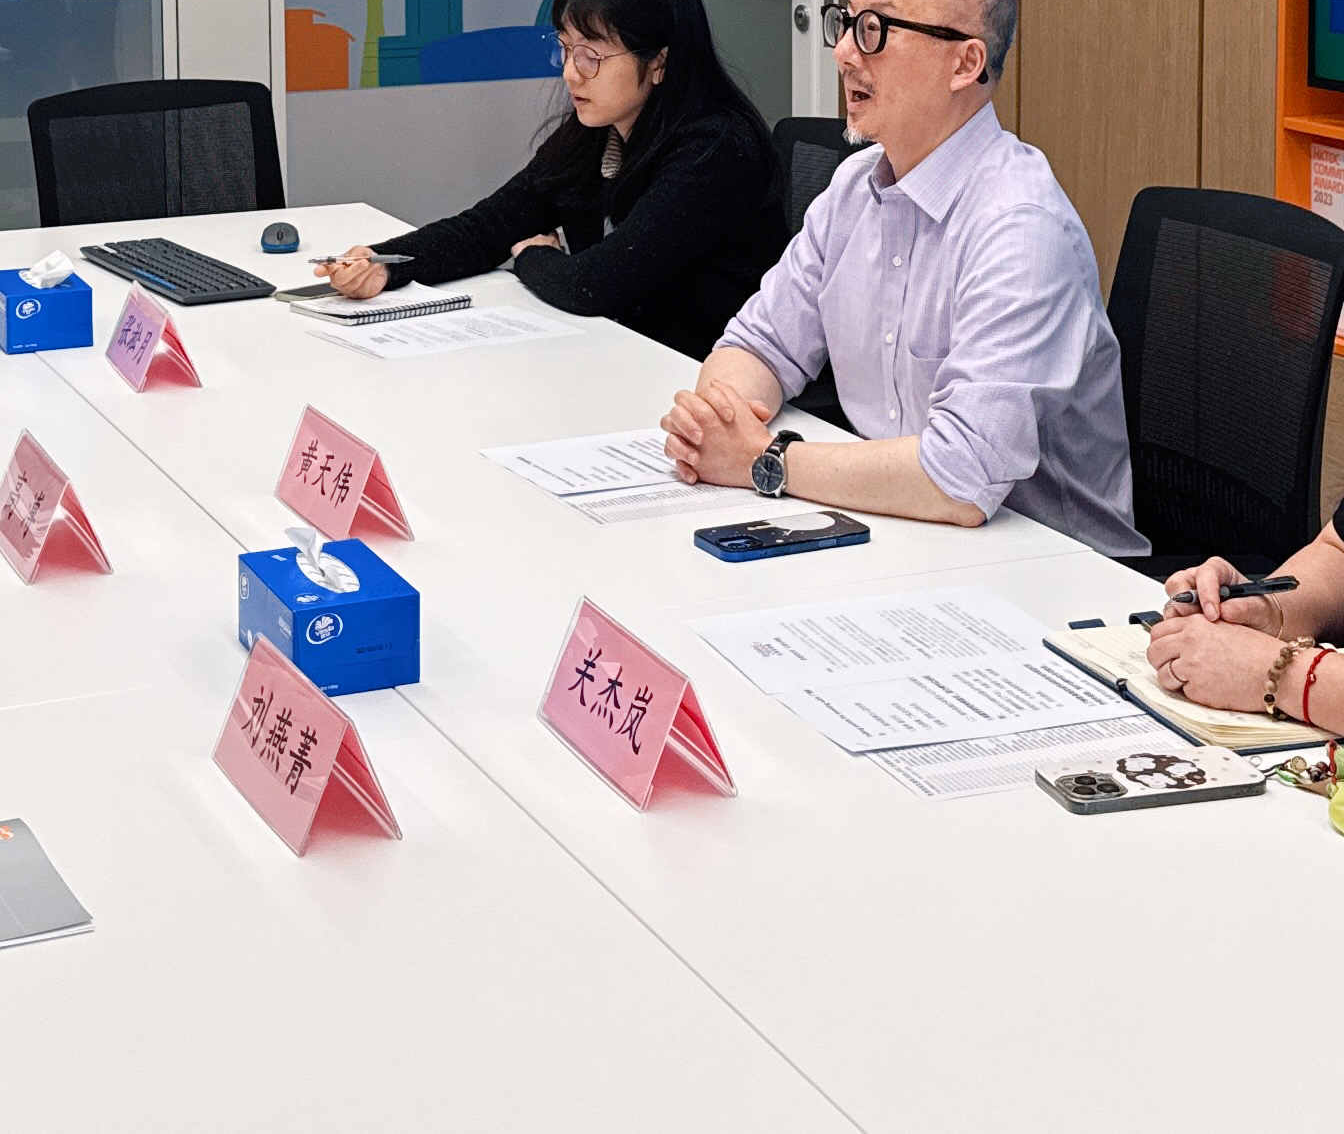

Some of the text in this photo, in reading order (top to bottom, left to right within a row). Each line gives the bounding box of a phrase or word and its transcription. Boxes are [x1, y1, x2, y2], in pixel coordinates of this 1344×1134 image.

[295, 439, 353, 509] 黄天伟
[241, 685, 318, 795] 刘燕菁
[567, 648, 654, 755] 关杰岚
